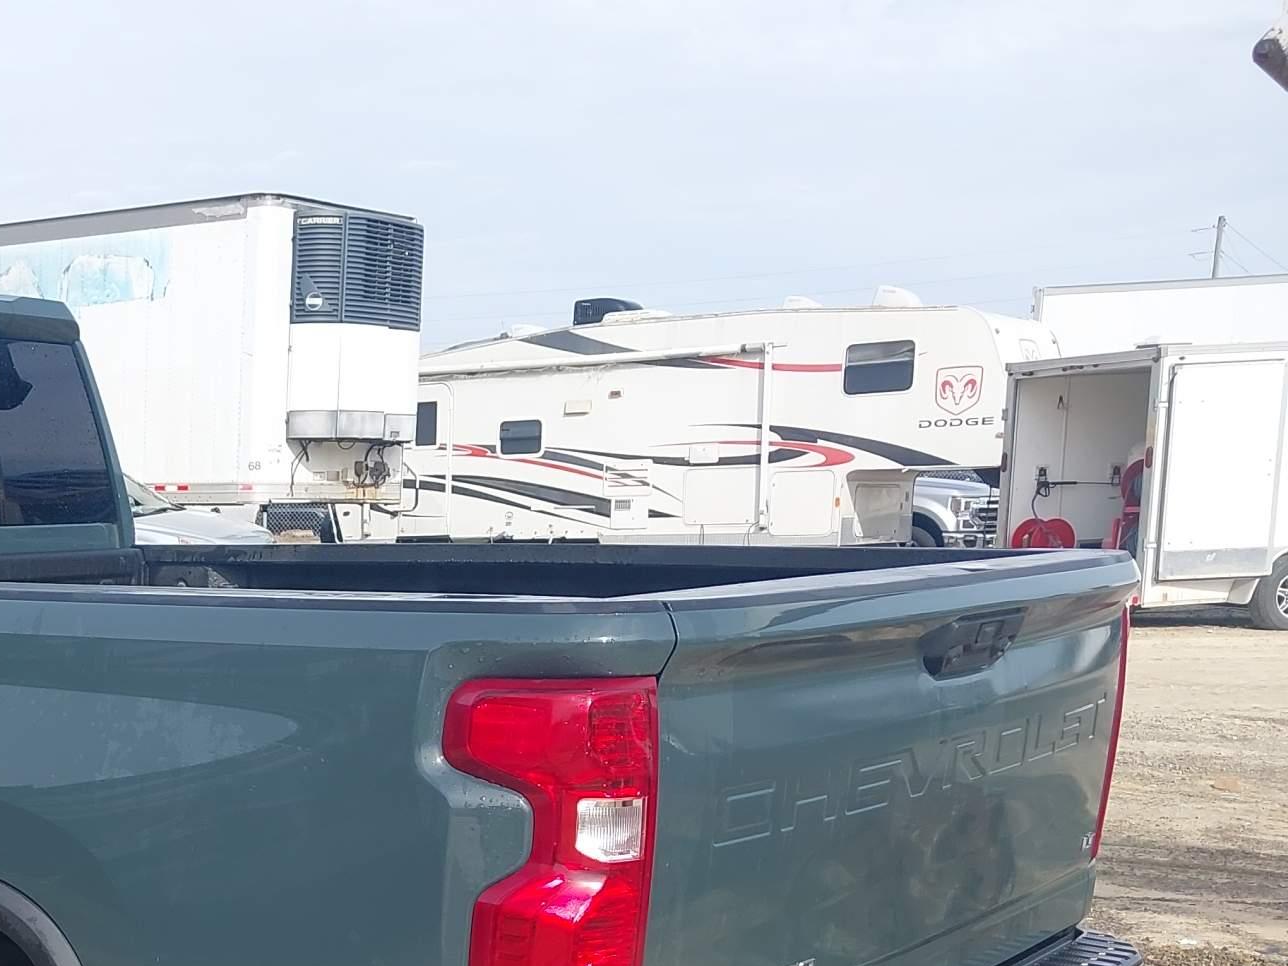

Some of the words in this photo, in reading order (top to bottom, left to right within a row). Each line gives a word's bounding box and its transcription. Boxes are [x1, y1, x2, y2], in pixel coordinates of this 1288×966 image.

[918, 417, 995, 429] DODGE
[248, 461, 261, 471] 68
[713, 692, 1108, 847] CHEVROLET
